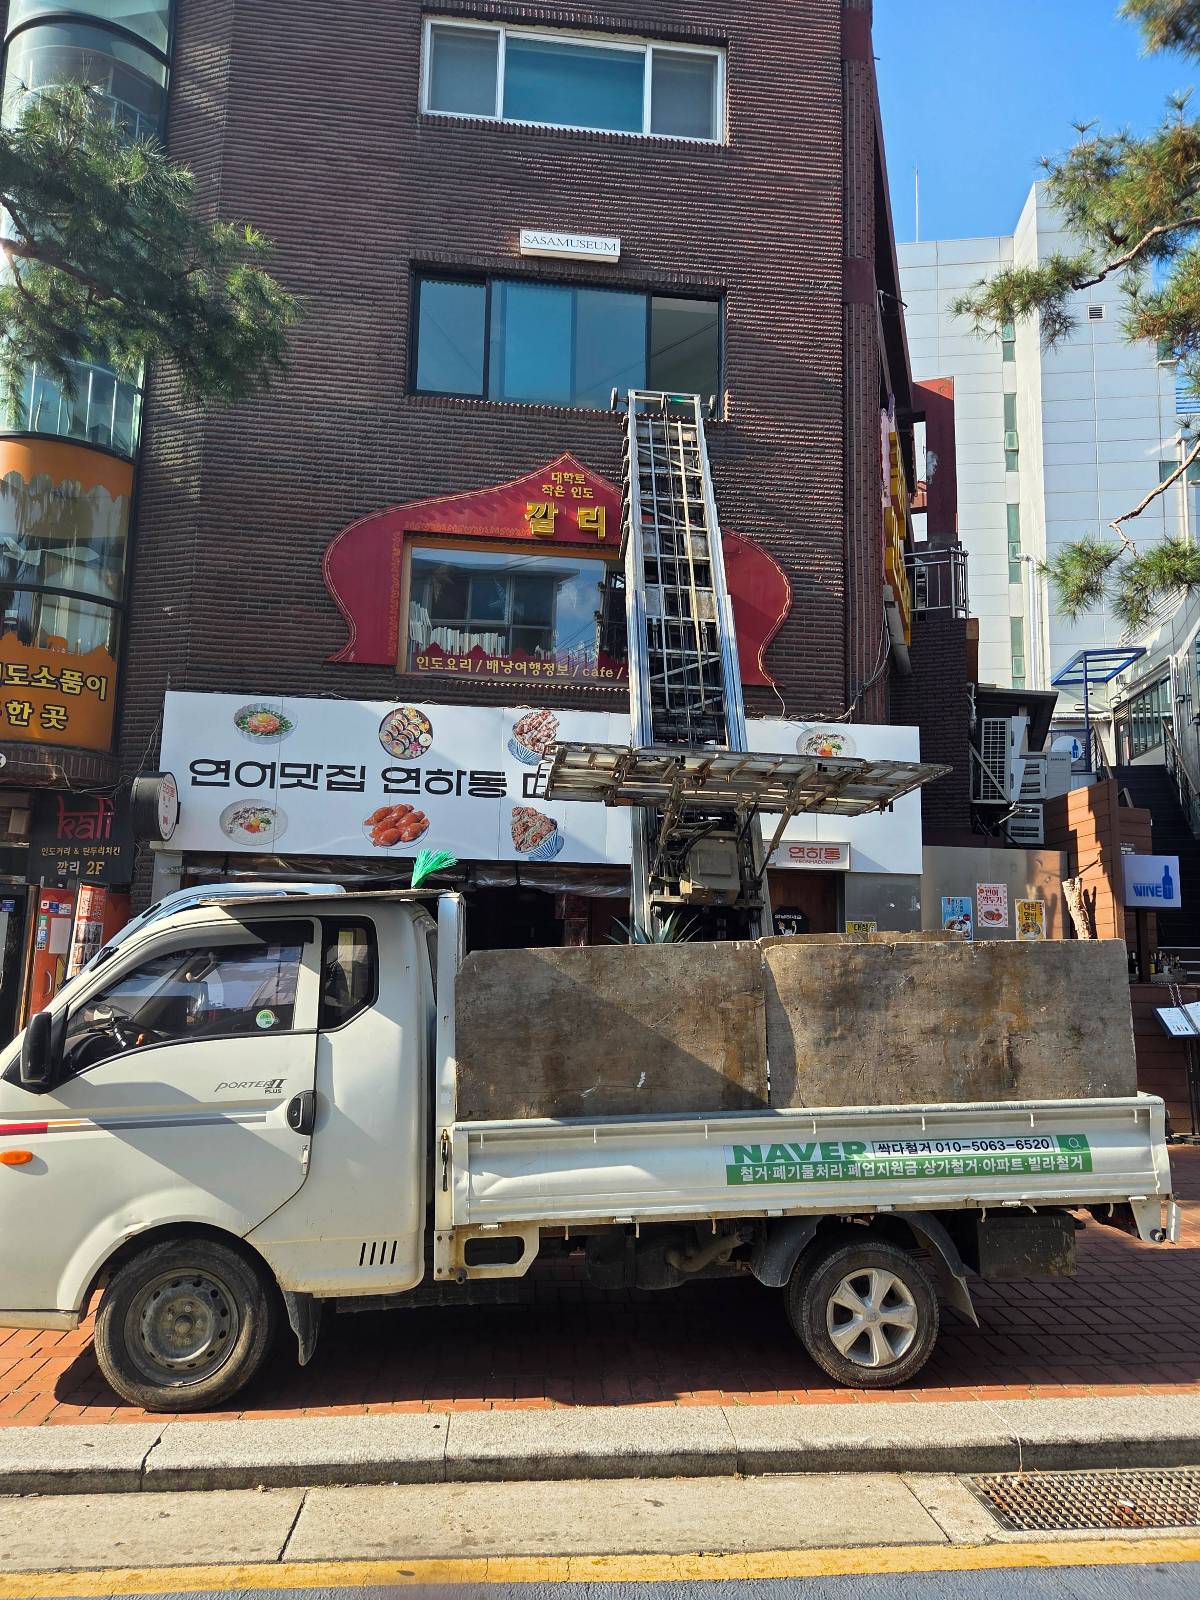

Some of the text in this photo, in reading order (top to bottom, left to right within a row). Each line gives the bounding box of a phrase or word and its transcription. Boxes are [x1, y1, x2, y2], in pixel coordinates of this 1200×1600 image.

[523, 234, 616, 251] SASAMUSEUM
[551, 472, 586, 484] 대학로
[542, 484, 594, 498] 작은 인도
[416, 656, 472, 672] 인도요리
[486, 659, 570, 676] 배낭여행정보
[582, 664, 613, 678] cafe
[0, 662, 108, 700] 도소품이
[40, 704, 68, 730] 곳
[188, 757, 366, 792] 연어맛집
[381, 765, 508, 799] 연하동
[57, 794, 115, 840] kali
[788, 846, 841, 860] 연하동
[57, 860, 105, 875] 깔리 2F
[1132, 885, 1162, 898] WINE
[732, 1138, 1051, 1164] NAVER 싹다철거 010-5063-6520
